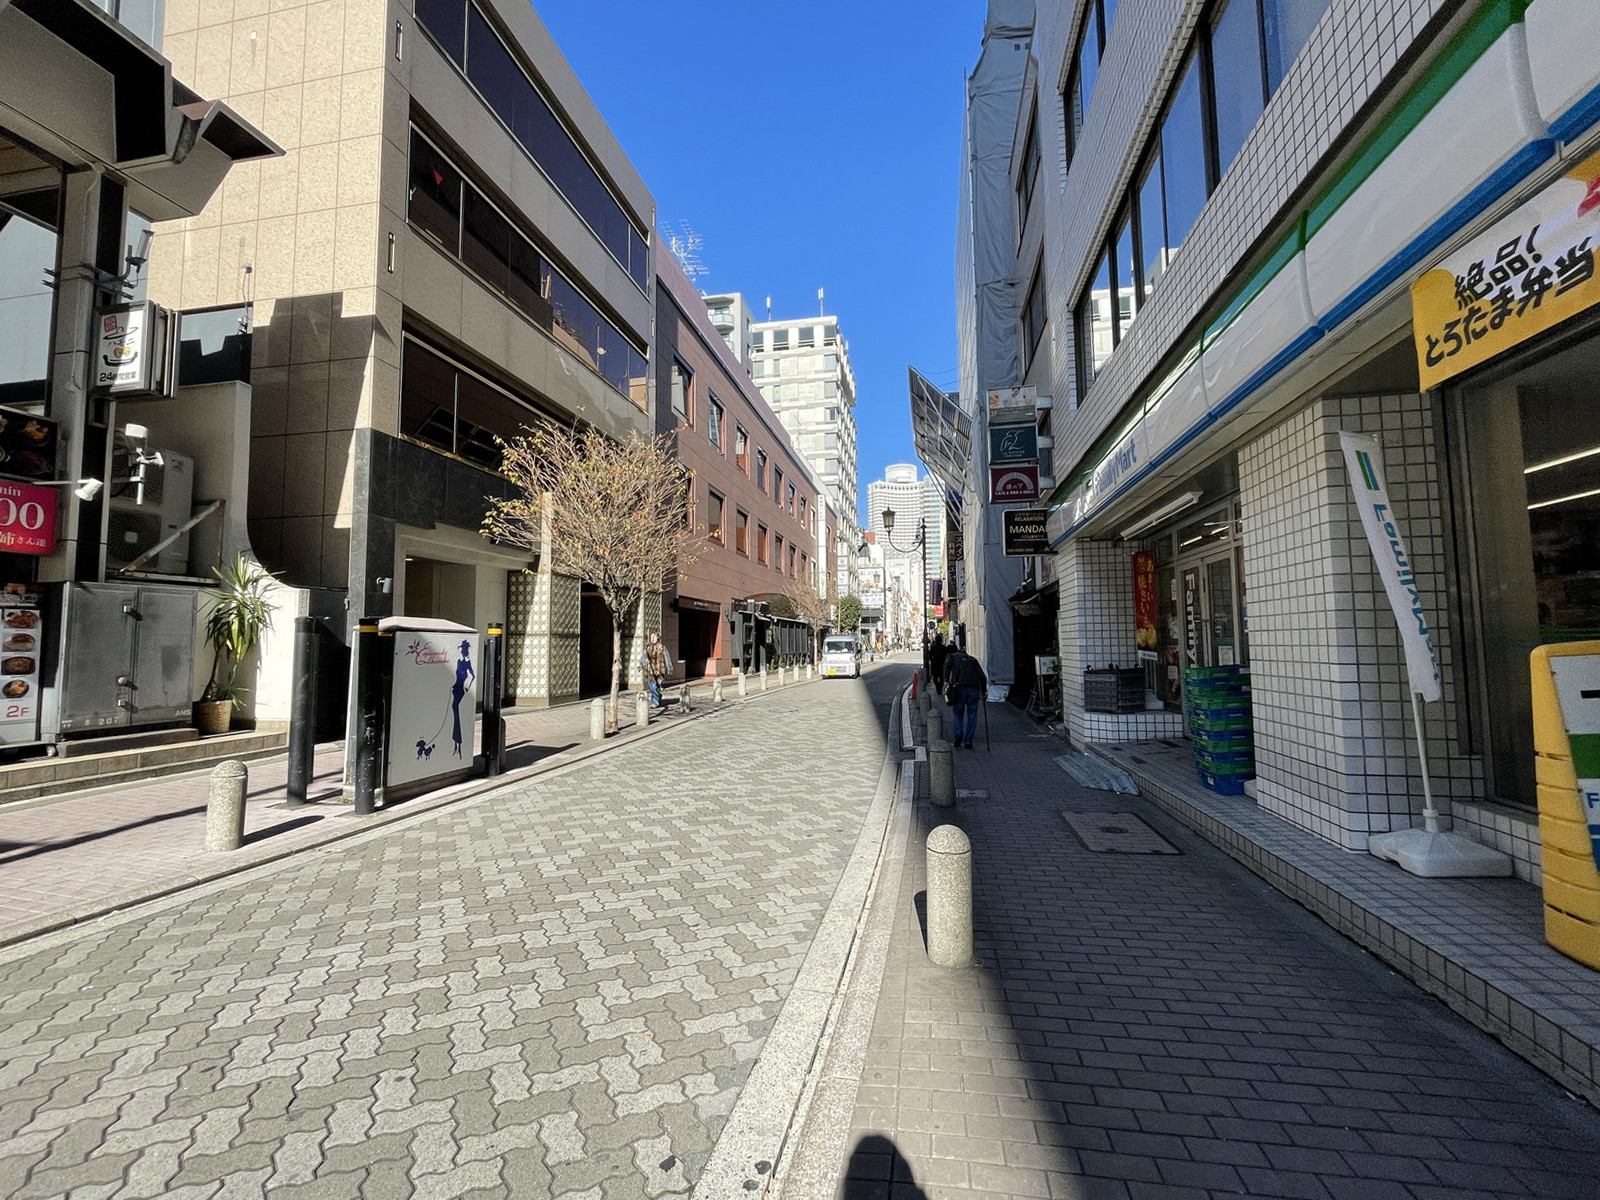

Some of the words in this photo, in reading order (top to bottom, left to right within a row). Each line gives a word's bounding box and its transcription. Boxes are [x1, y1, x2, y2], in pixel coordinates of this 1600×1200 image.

[1425, 236, 1595, 368] とろたま弁当
[6, 705, 29, 718] 2F
